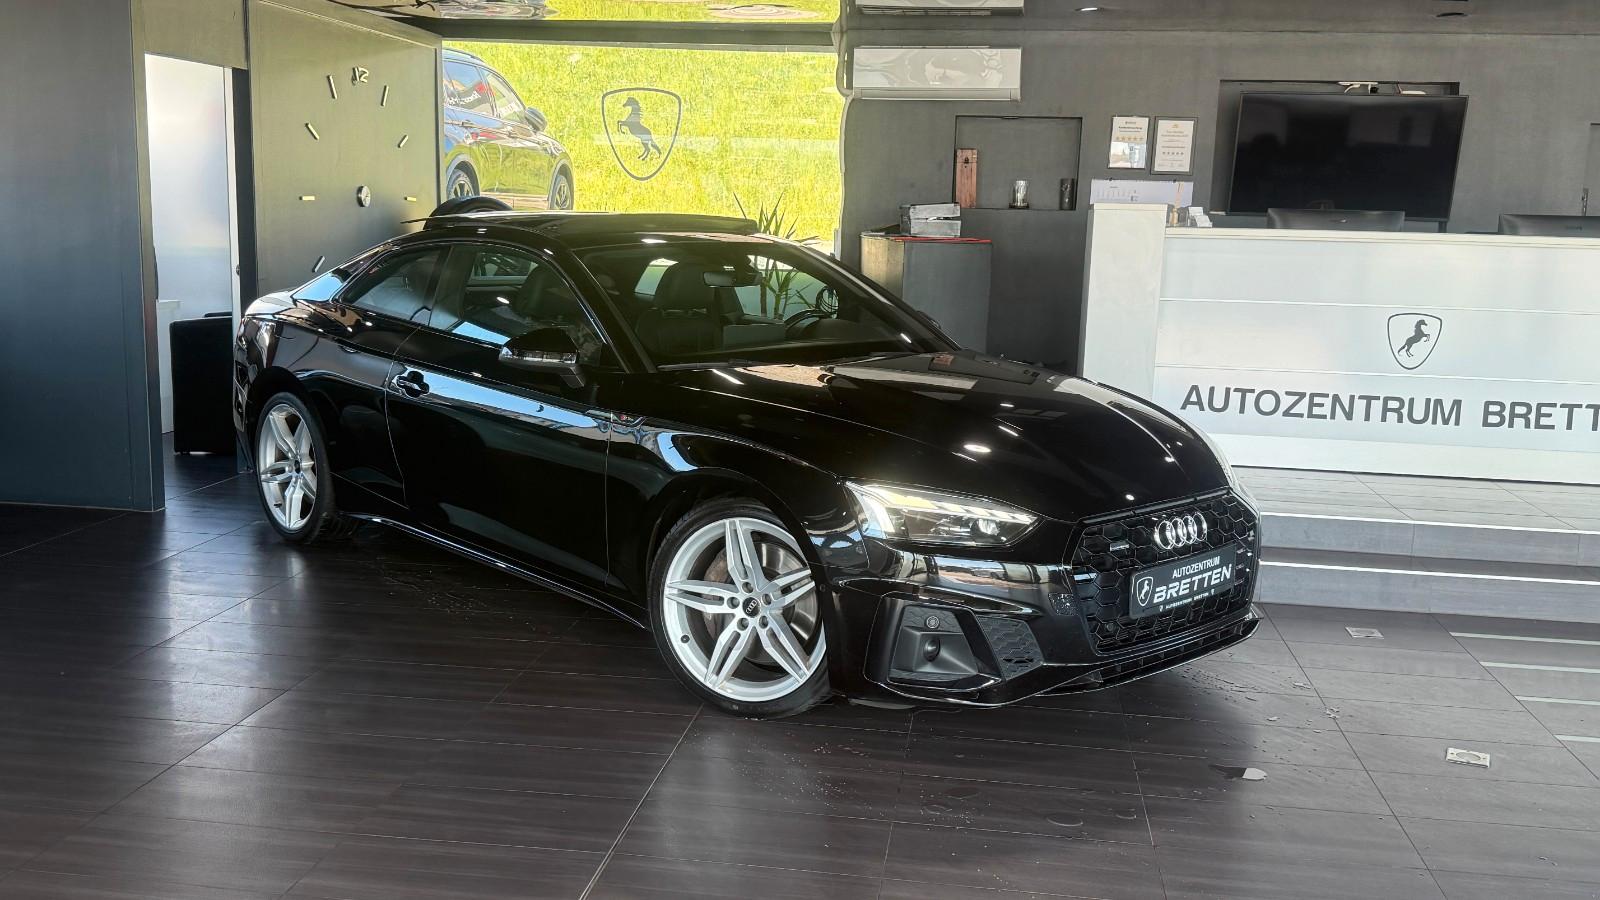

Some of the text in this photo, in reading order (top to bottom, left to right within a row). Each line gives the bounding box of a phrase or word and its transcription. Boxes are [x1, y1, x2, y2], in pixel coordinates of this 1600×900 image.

[352, 67, 369, 83] 12
[1180, 384, 1600, 431] AUTOZENTRUM BRETT
[1172, 555, 1220, 579] AUTOZENTRUM
[1153, 563, 1232, 604] BRETTEN
